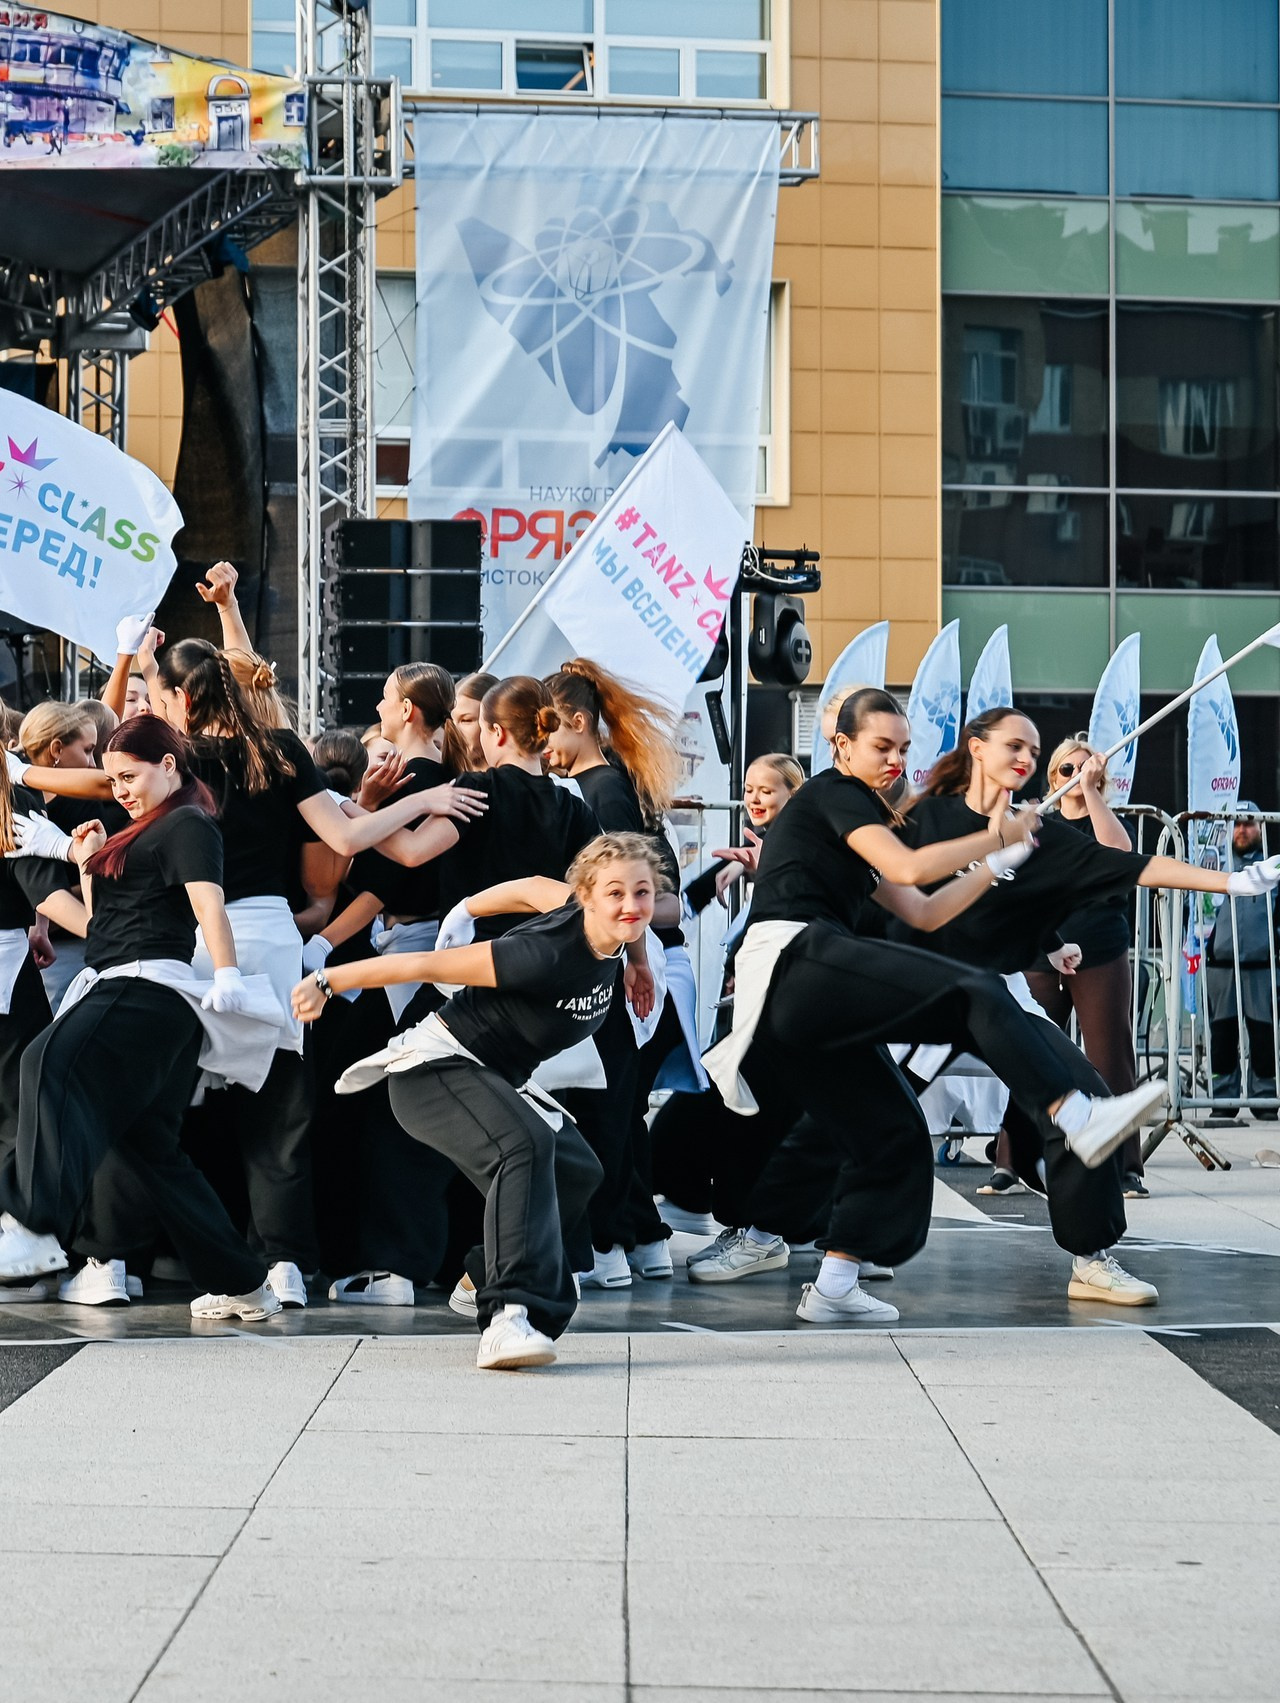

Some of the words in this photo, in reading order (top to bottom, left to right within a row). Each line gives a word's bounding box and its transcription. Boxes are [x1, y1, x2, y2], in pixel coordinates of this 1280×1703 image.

[37, 482, 161, 563] CLASS
[592, 536, 629, 585] МЫ
[614, 505, 696, 600] #TANZ
